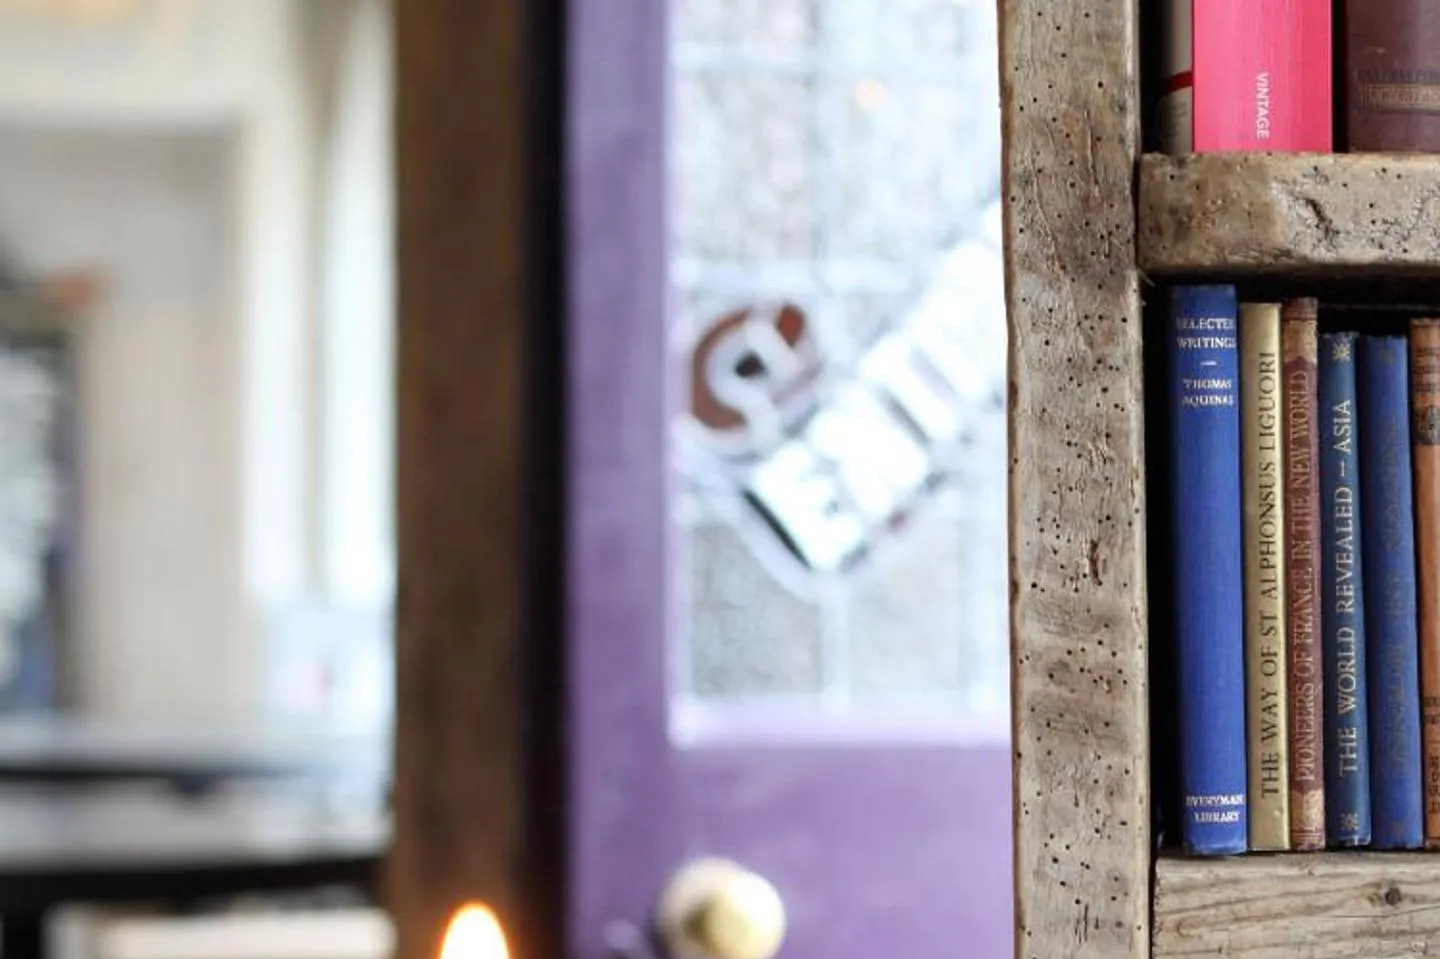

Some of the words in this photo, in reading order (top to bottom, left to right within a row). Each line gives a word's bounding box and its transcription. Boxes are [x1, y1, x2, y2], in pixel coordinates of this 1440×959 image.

[1257, 72, 1270, 141] VINTAGE
[1183, 379, 1232, 389] THOMAS
[1183, 395, 1234, 406] AQUINAS
[1259, 352, 1278, 450] LIGUORI
[1289, 371, 1309, 436] WORLD
[1332, 400, 1351, 456] ASIA
[1290, 447, 1310, 490] NEW
[1259, 462, 1278, 600] ALPHONSUS
[1290, 493, 1311, 531] THE
[1291, 538, 1312, 560] IN
[1335, 487, 1354, 615] REVEALED
[1261, 611, 1278, 641] ST
[1261, 644, 1278, 677] OF
[1294, 649, 1314, 678] OF
[1337, 627, 1356, 716] WORLD
[1261, 688, 1279, 745] WAY
[1295, 682, 1315, 781] PIONEERS
[1261, 752, 1279, 798] THE
[1340, 727, 1357, 777] THE
[1186, 794, 1245, 806] EVERYMAN
[1194, 811, 1240, 823] LIBRARY
